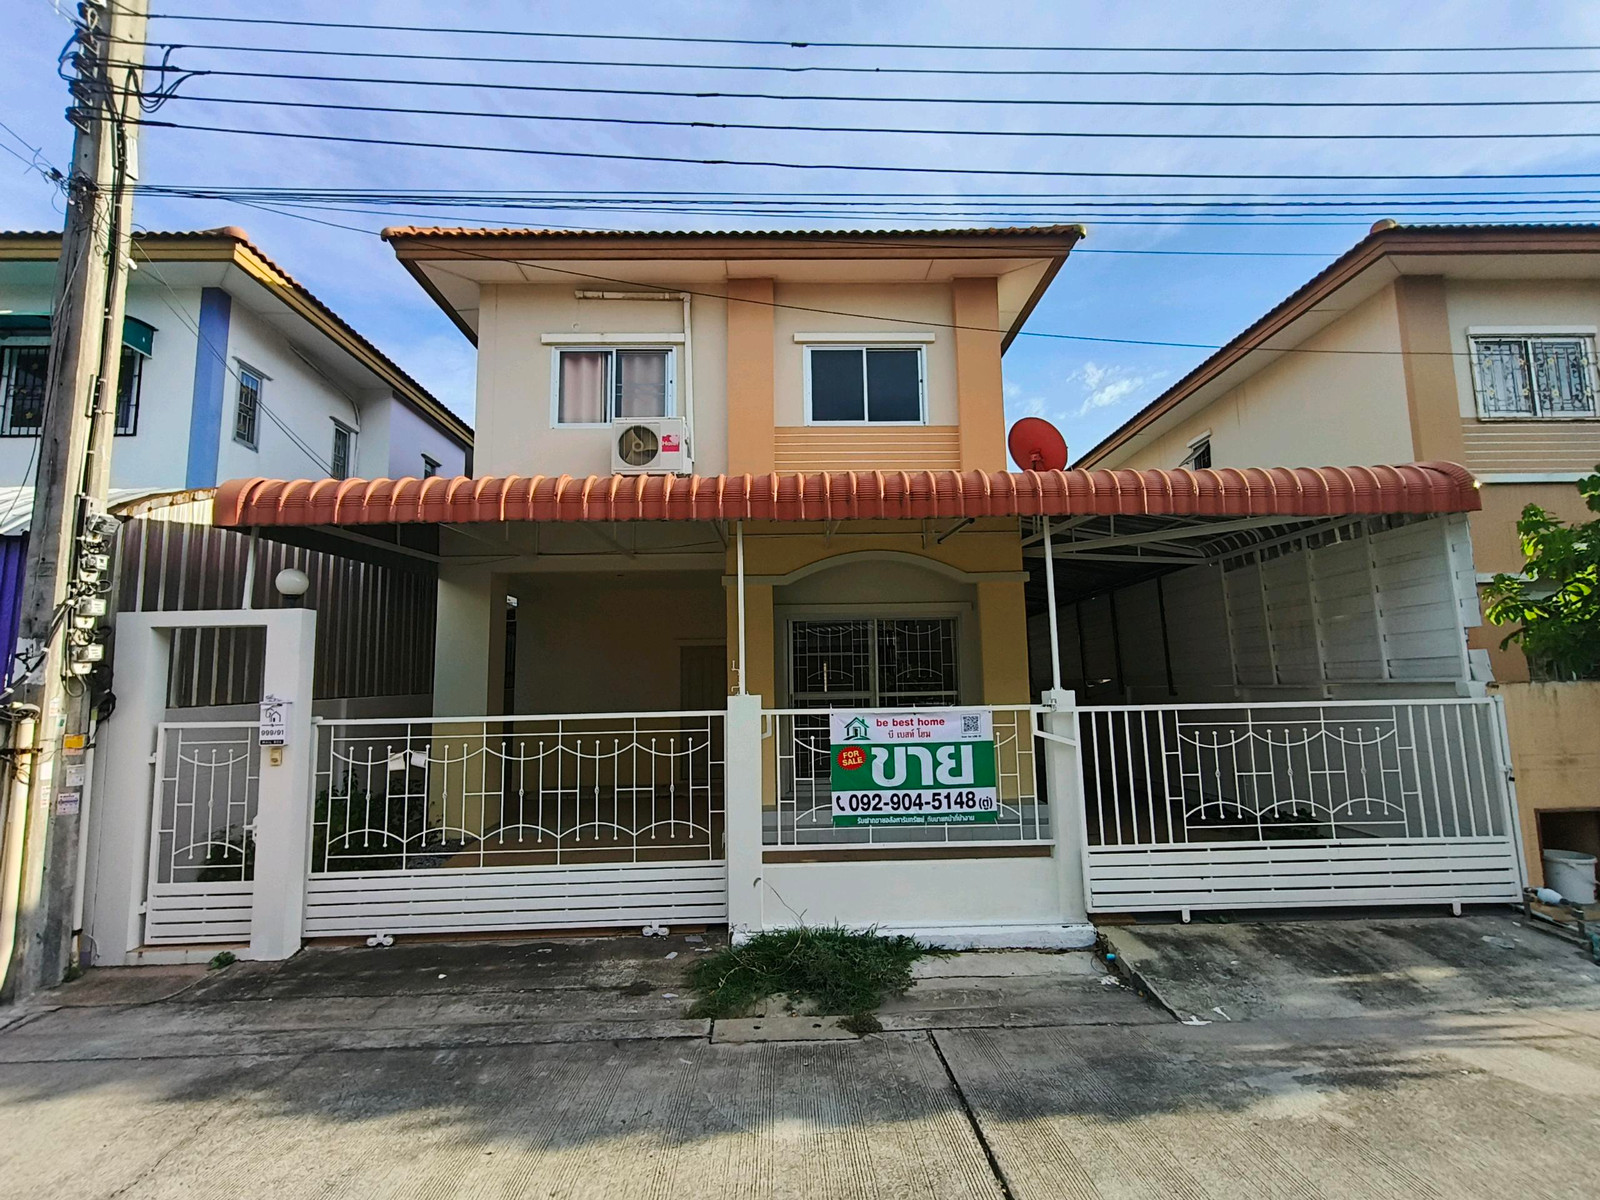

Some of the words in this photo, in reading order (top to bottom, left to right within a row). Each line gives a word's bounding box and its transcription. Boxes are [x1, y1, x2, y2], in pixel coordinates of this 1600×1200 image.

[876, 719, 889, 727] be
[892, 718, 914, 726] best
[917, 718, 945, 726] home
[842, 750, 860, 758] FOR
[841, 757, 863, 766] SALE
[871, 744, 975, 788] ขาย
[849, 791, 977, 812] 092-904-5148
